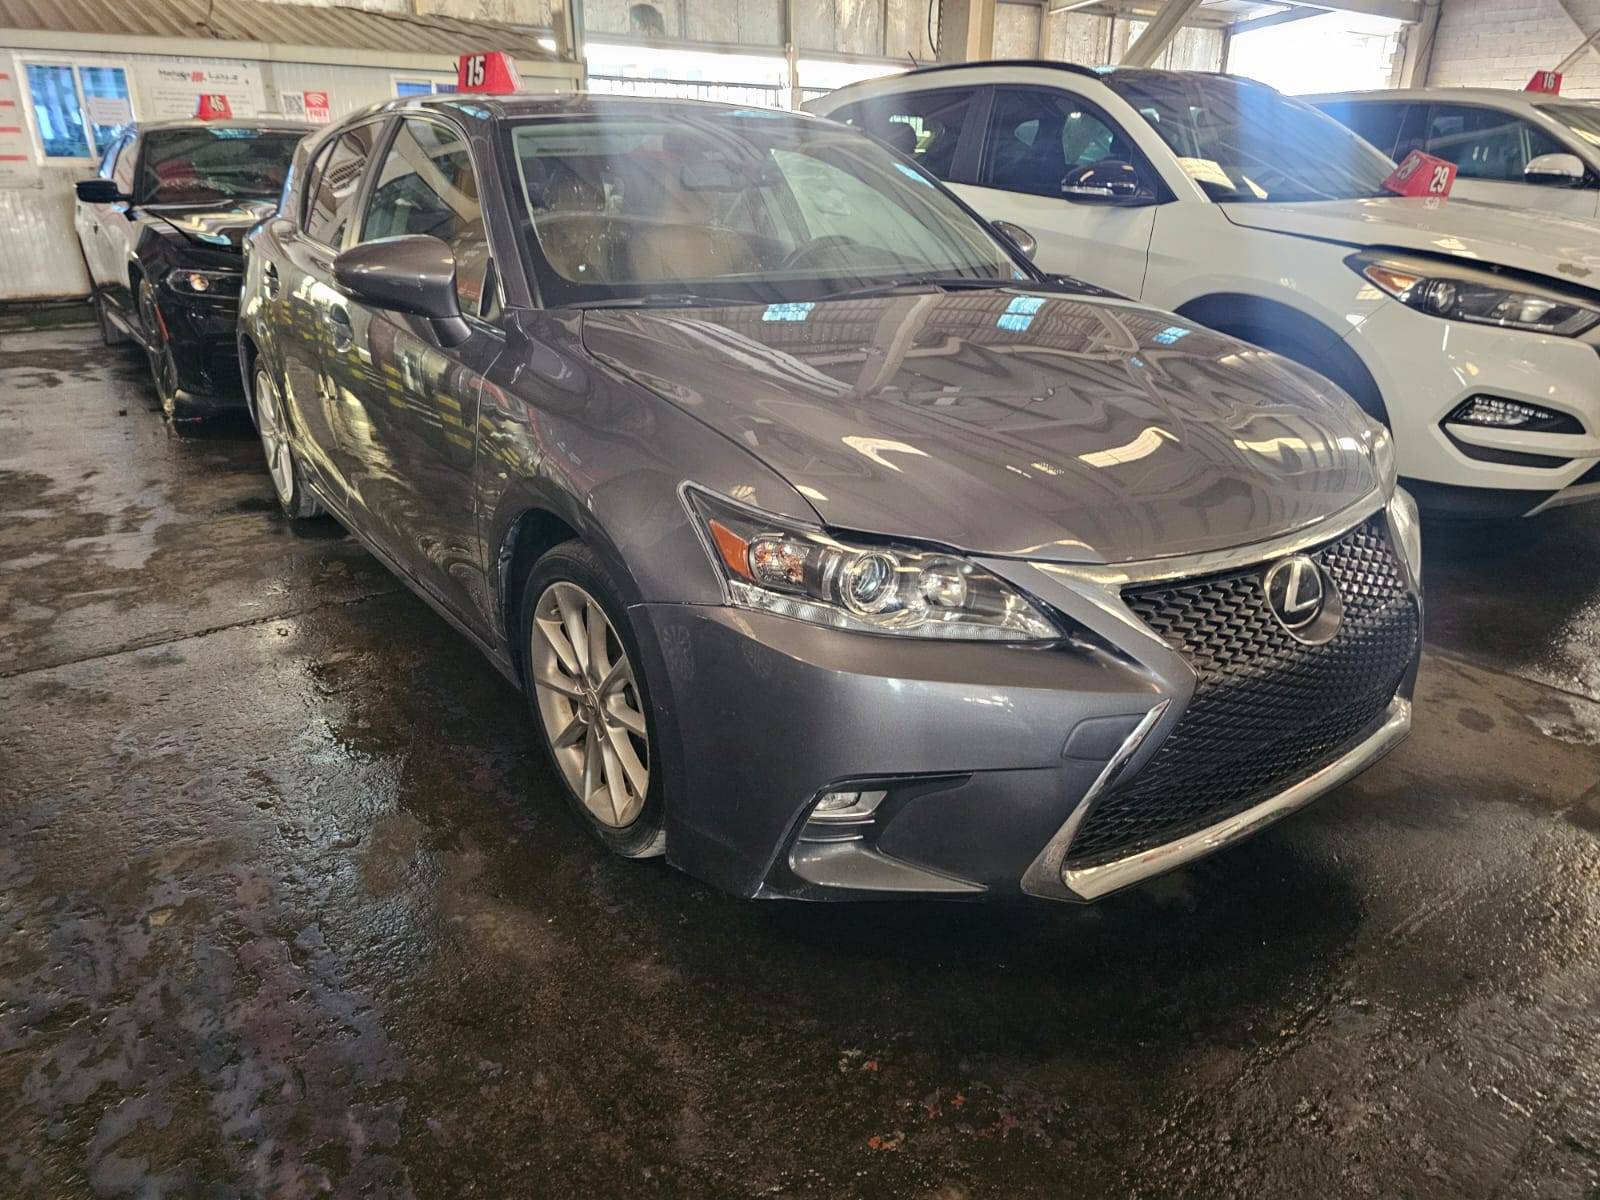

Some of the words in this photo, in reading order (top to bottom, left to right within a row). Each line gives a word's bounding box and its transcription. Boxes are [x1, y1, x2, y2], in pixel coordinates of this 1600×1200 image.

[467, 55, 485, 87] 15
[1543, 71, 1555, 89] 16
[1429, 165, 1450, 193] 29
